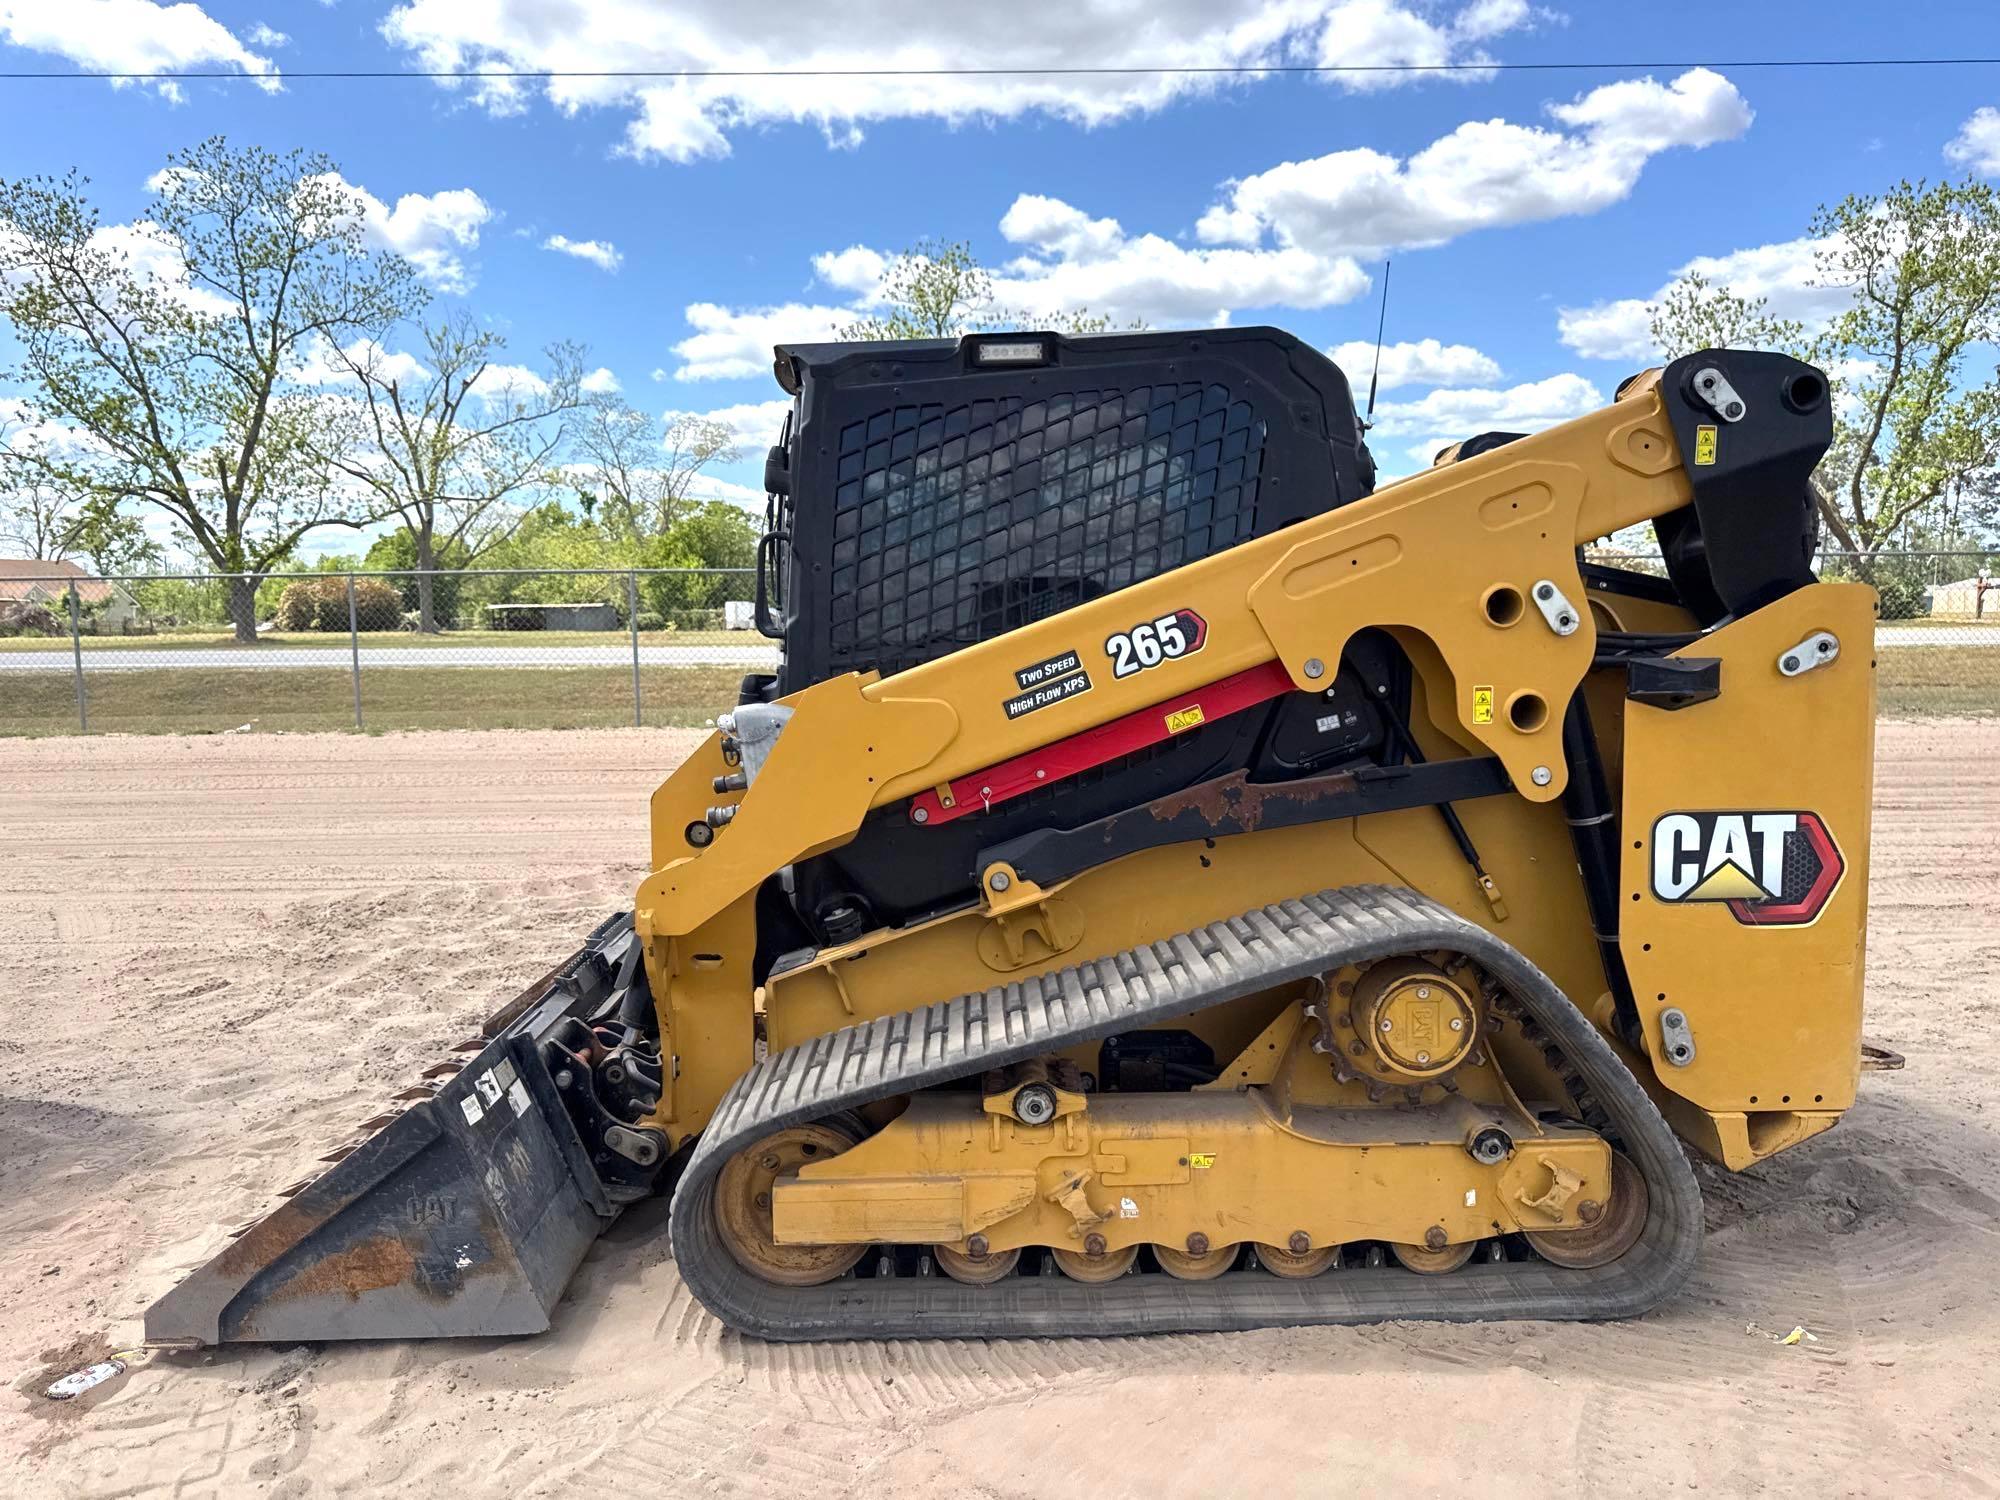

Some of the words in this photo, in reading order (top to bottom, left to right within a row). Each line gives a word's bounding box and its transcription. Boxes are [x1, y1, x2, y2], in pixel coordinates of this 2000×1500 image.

[1107, 615, 1186, 677] 265
[1063, 676, 1086, 695] XPS
[1654, 814, 1797, 900] CAT
[406, 1196, 457, 1224] CAT
